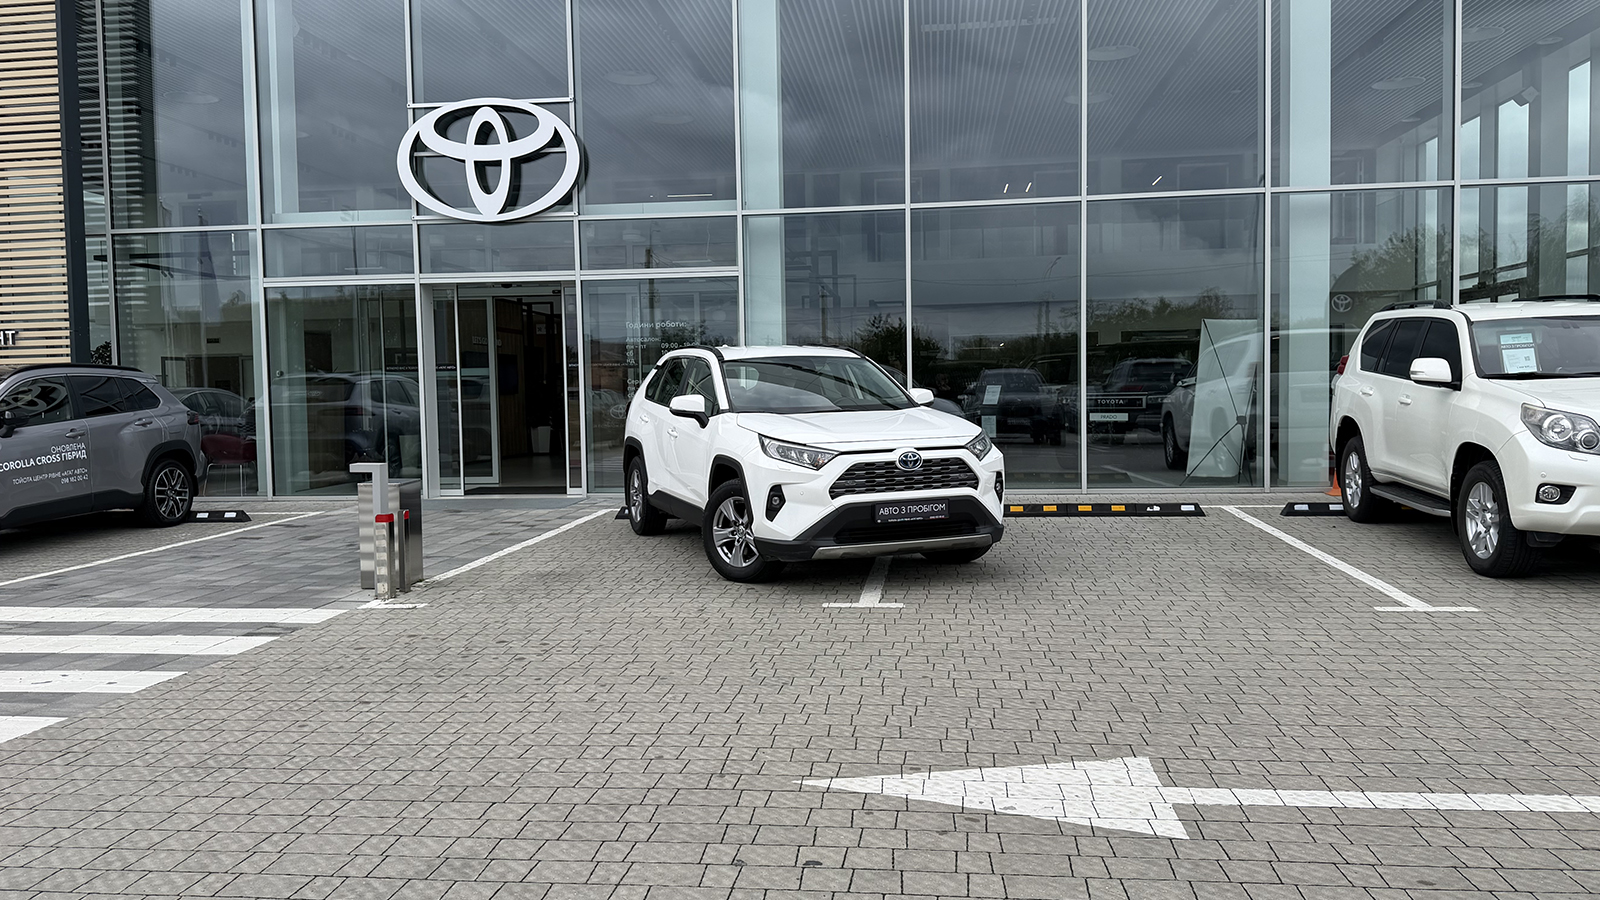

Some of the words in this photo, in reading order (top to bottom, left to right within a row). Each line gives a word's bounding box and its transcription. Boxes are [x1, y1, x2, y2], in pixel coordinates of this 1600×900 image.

[626, 321, 654, 329] Години
[655, 320, 687, 330] роботи:
[51, 442, 86, 453] ОНОВЛЕНА
[36, 453, 61, 465] CROSS
[62, 450, 87, 461] ГІБРИД
[879, 506, 900, 516] АВТО
[901, 506, 906, 514] З
[907, 503, 946, 514] ПРОБІГОМ
